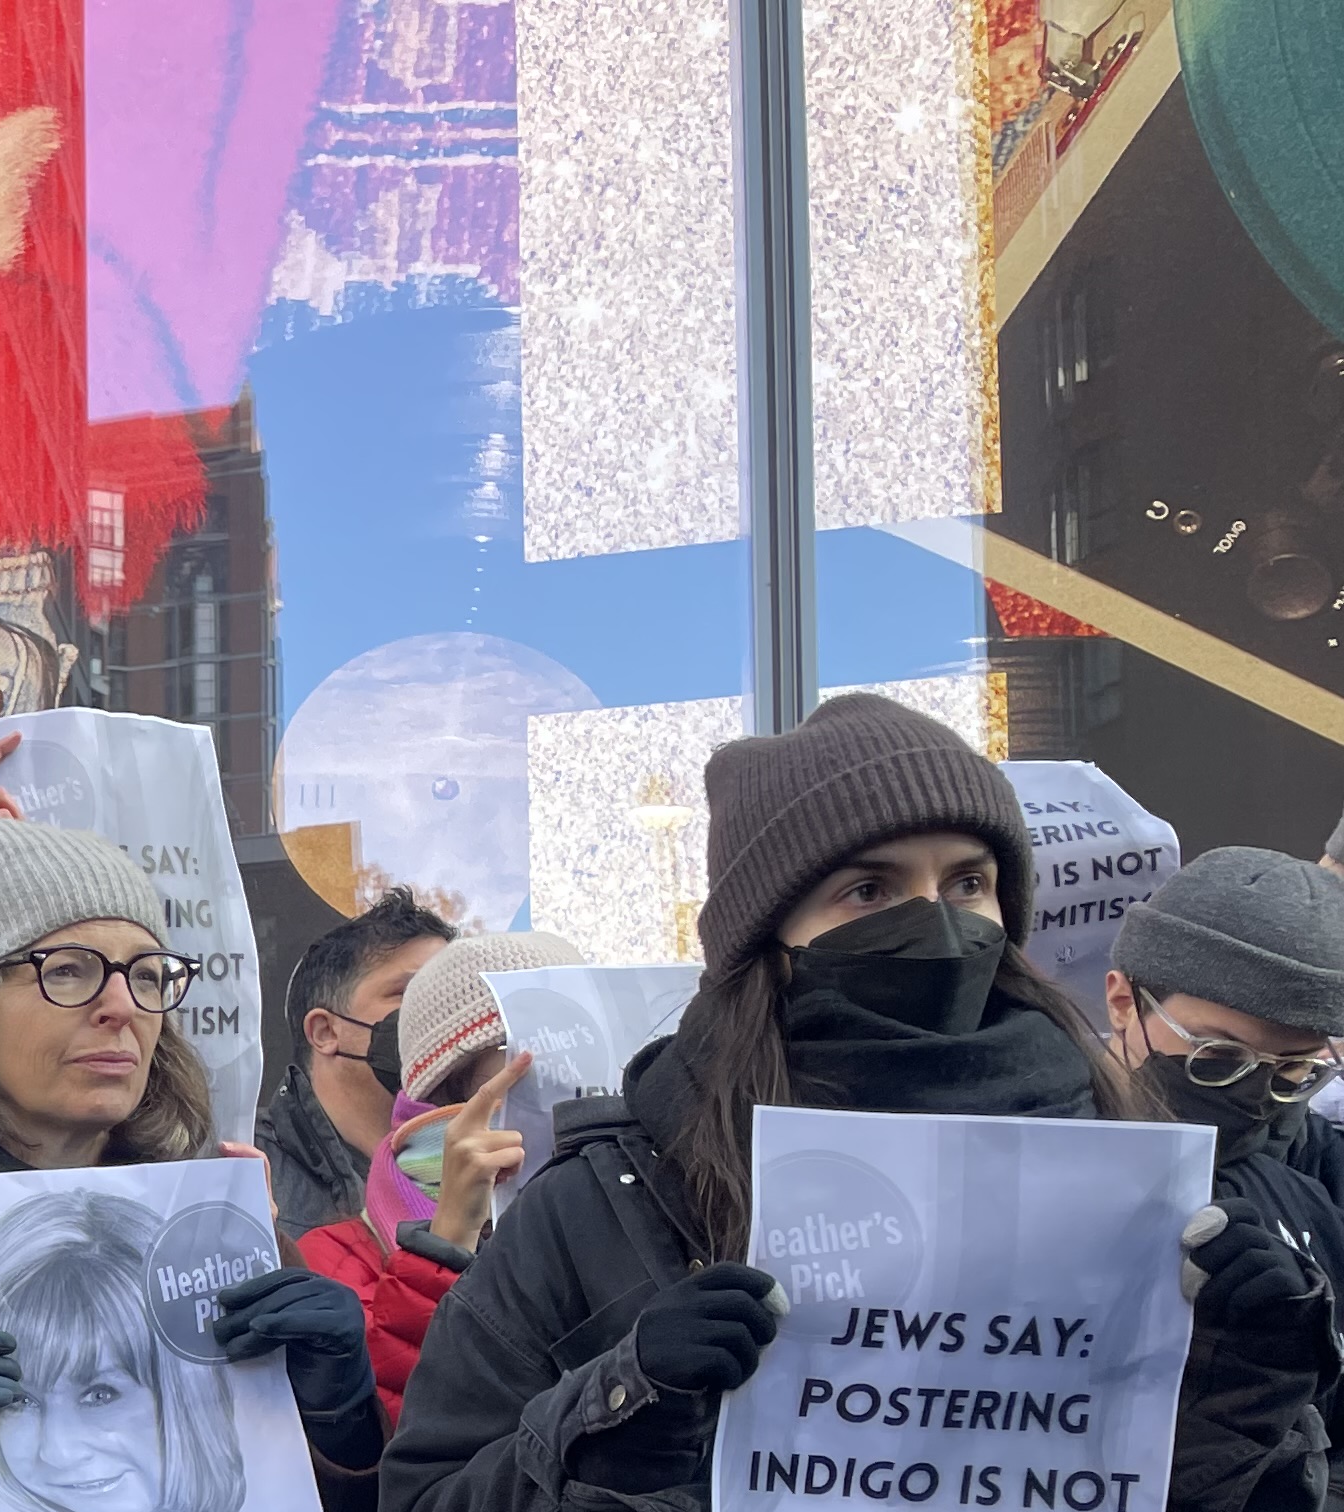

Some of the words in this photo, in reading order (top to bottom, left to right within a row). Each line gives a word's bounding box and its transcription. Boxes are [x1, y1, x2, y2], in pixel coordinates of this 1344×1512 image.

[16, 776, 84, 812] ther's
[1024, 800, 1094, 815] SAY:
[1027, 821, 1119, 847] ERING
[142, 845, 200, 875] SAY:
[1053, 861, 1079, 887] IS
[1092, 847, 1162, 881] NOT
[517, 1023, 595, 1057] eather's
[533, 1055, 583, 1089] Pick
[156, 1247, 276, 1302] Heather's
[790, 1259, 866, 1305] Pick
[194, 1295, 227, 1334] Pi
[831, 1307, 967, 1353] JEWS
[983, 1314, 1095, 1359] SAY:
[798, 1378, 1091, 1434] POSTERING
[749, 1450, 940, 1503] INDIGO
[959, 1465, 1003, 1506] IS
